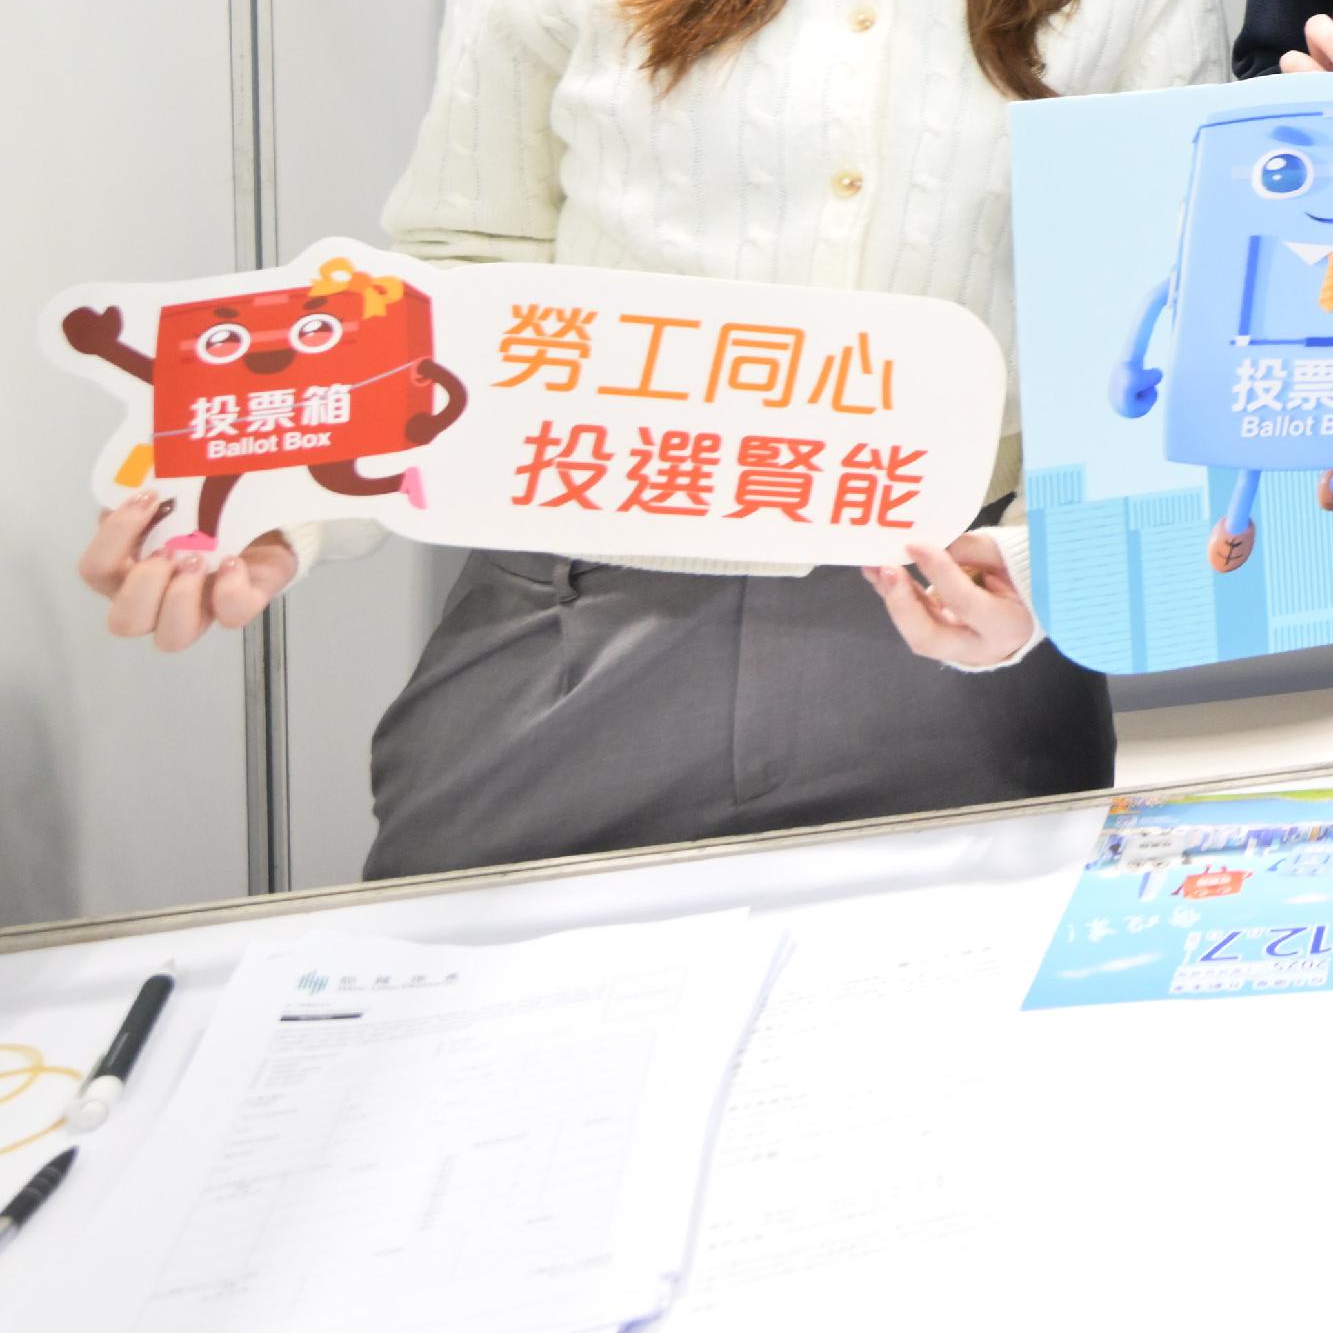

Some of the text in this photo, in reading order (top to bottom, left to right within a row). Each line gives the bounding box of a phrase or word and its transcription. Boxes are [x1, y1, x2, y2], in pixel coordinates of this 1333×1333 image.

[492, 302, 895, 415] 勞工同心
[189, 383, 352, 440] 投票箱
[1241, 415, 1314, 438] Ballot
[207, 430, 332, 459] Ballot Box
[509, 419, 928, 529] 投選賢能
